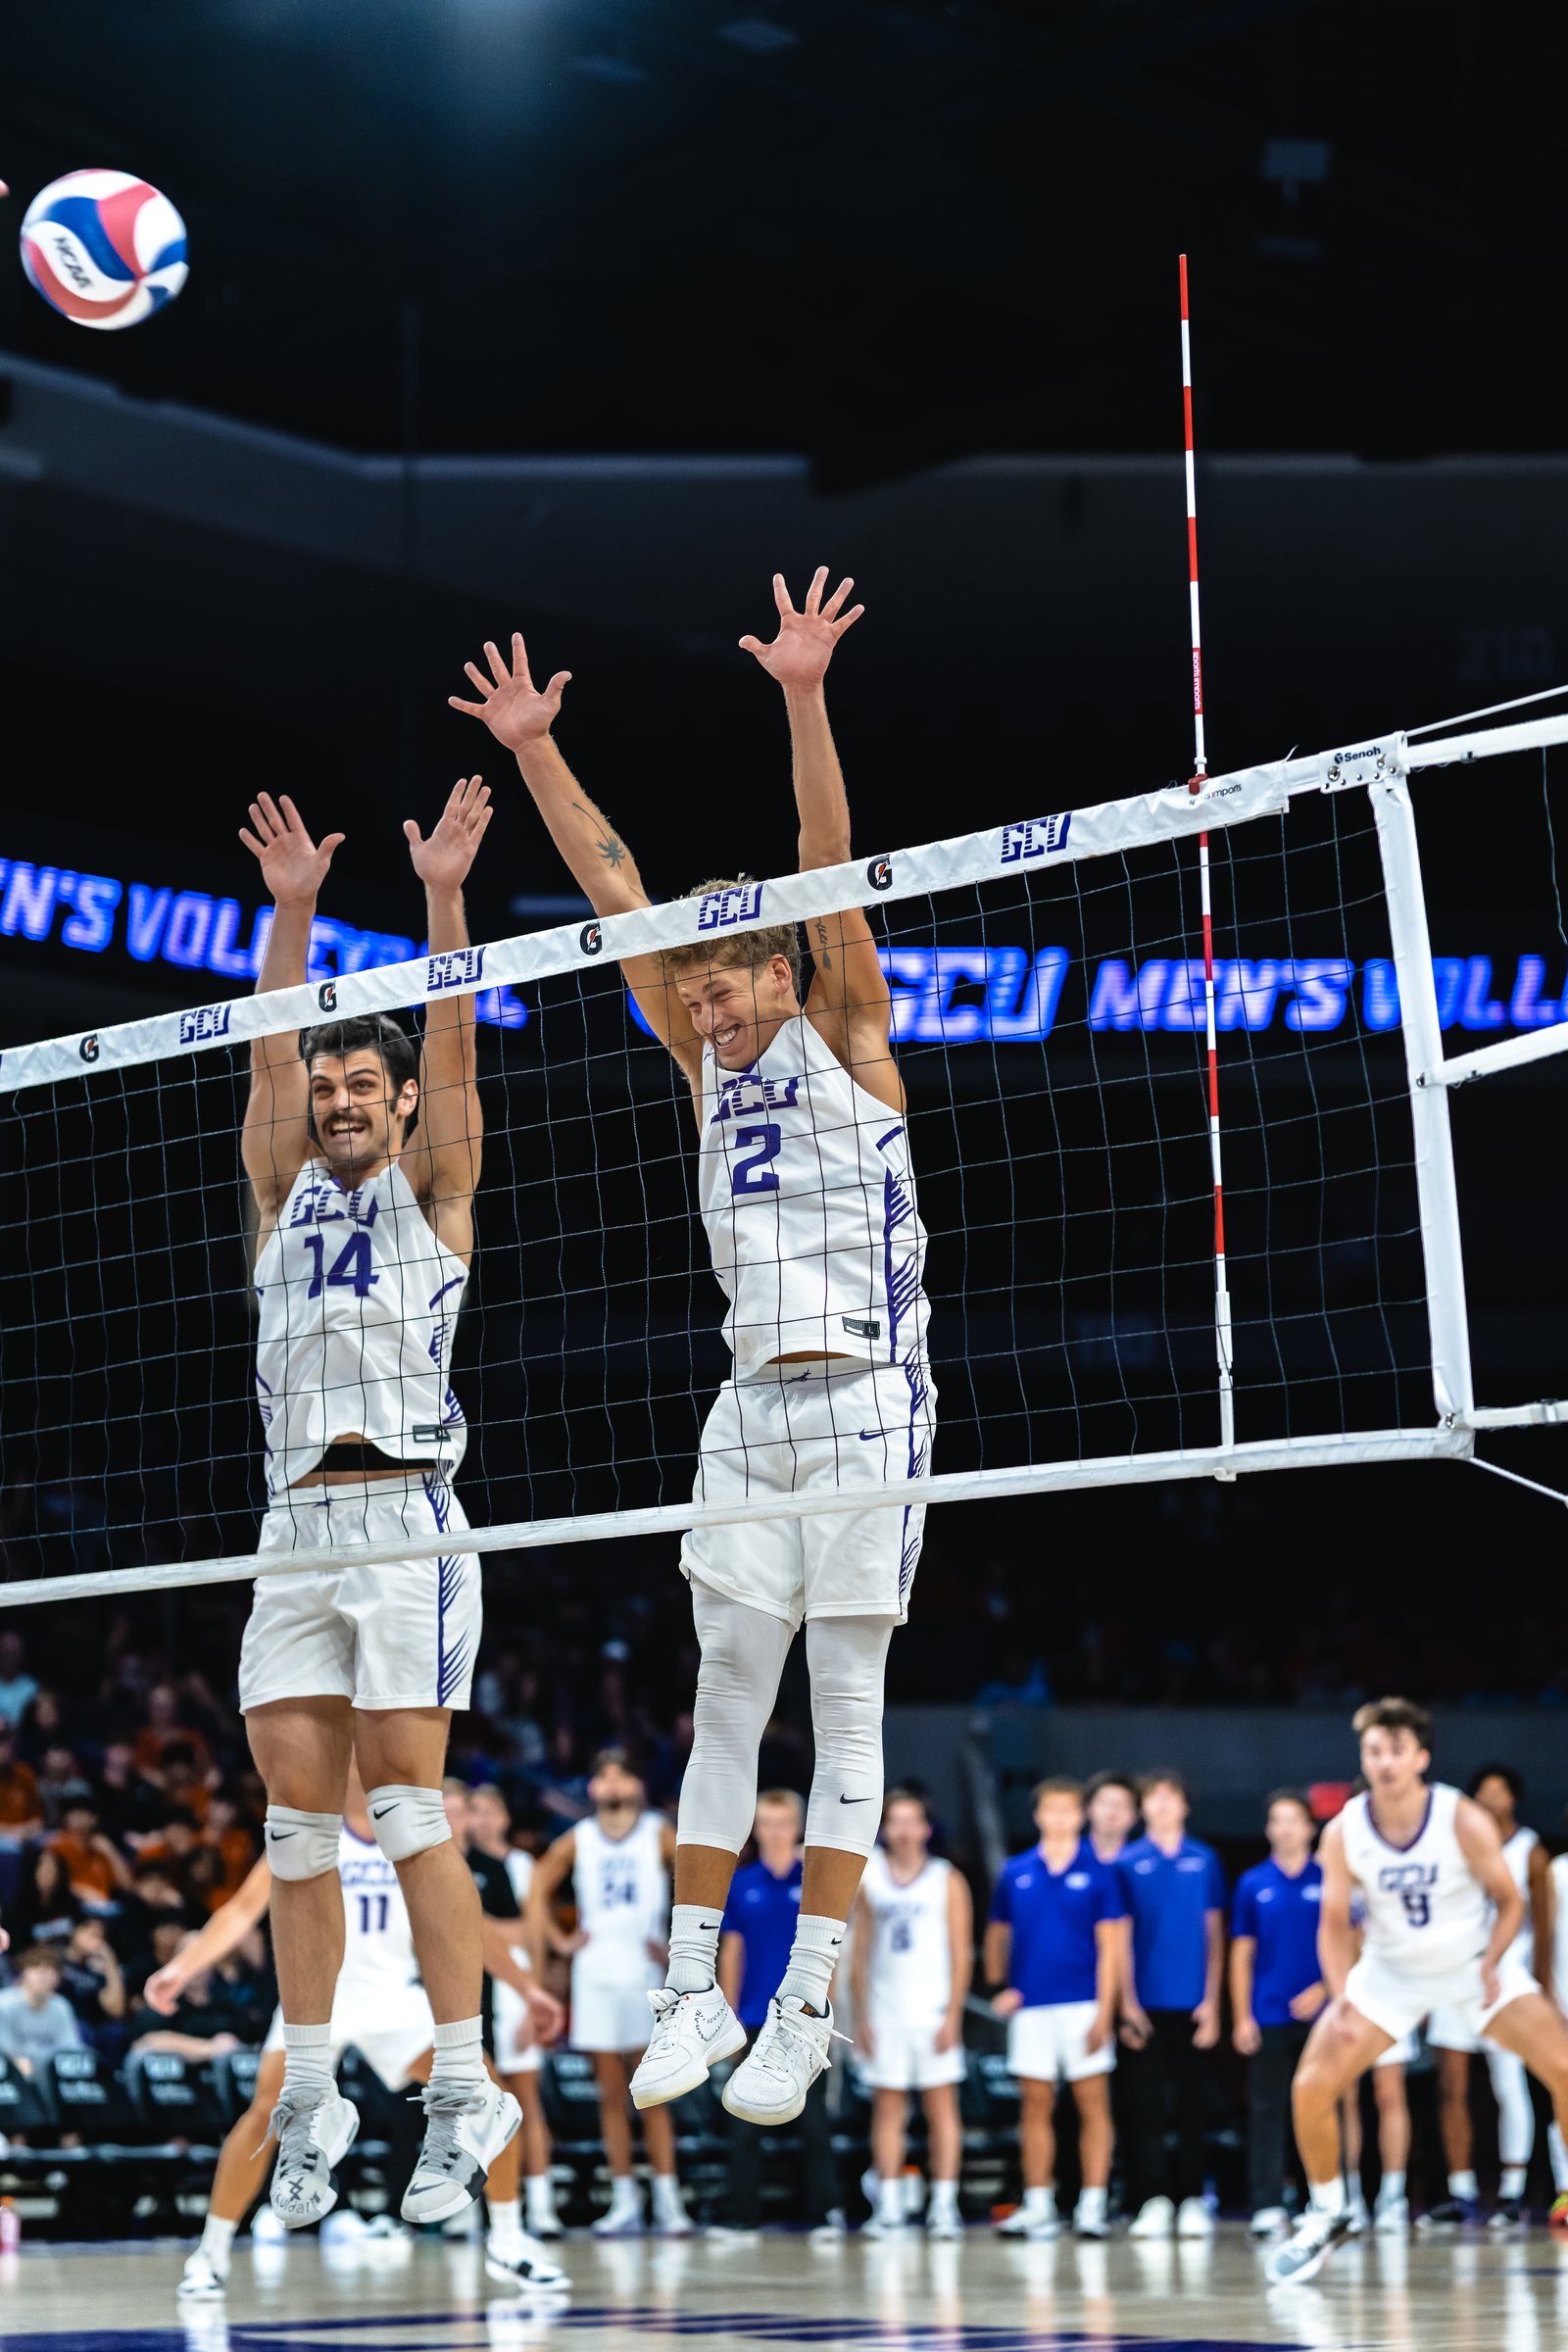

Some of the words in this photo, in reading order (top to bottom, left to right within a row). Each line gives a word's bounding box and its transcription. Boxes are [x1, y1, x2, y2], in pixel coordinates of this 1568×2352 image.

[52, 236, 93, 289] NCAA
[1344, 746, 1382, 762] Senoh
[1000, 811, 1073, 863] GCU
[0, 858, 123, 954] N'S
[698, 882, 764, 931] GCU
[426, 946, 487, 992] GCU
[877, 947, 1070, 1042] GCU
[1087, 958, 1355, 1032] MEN'S
[179, 1003, 231, 1045] GCU
[731, 1123, 782, 1196] 2
[290, 1185, 379, 1229] GCU
[303, 1231, 380, 1299] 14
[356, 1892, 390, 1935] 11
[1401, 1891, 1431, 1930] 9
